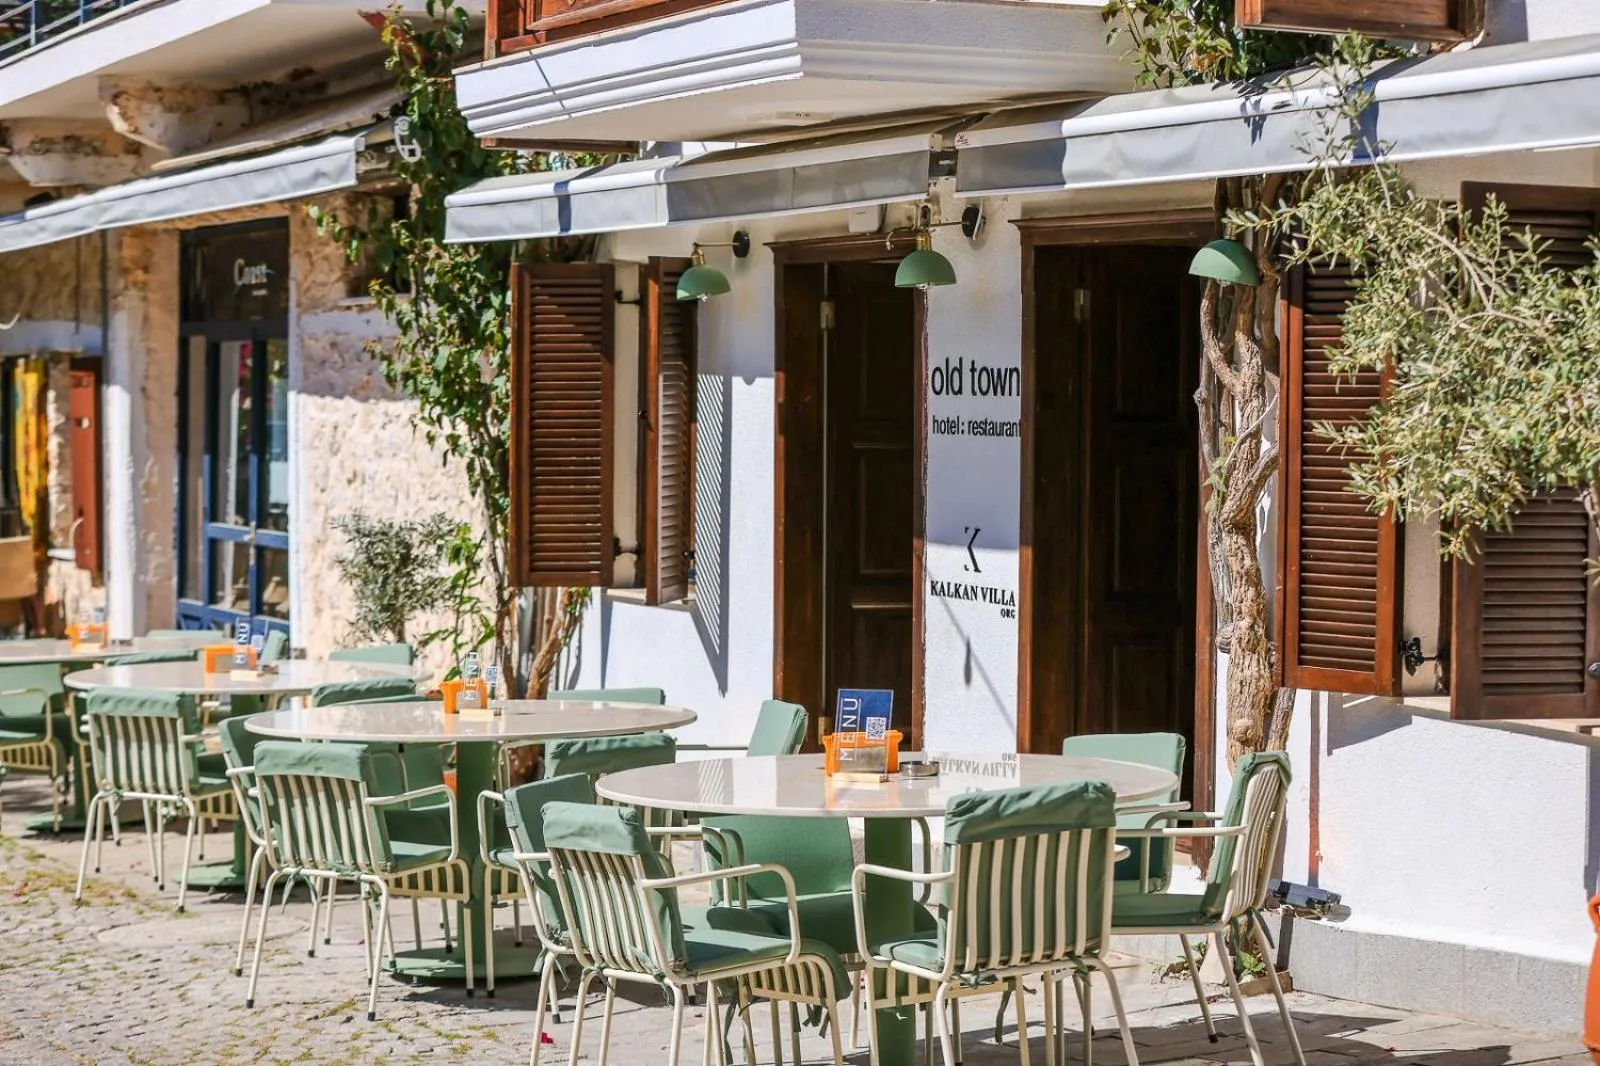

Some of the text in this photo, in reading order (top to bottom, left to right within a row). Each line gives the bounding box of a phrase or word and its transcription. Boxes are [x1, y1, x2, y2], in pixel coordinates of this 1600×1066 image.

[931, 356, 1020, 397] old town
[930, 580, 1016, 607] KALKAN VILLA
[1000, 608, 1016, 619] ORG
[839, 698, 859, 761] MENU
